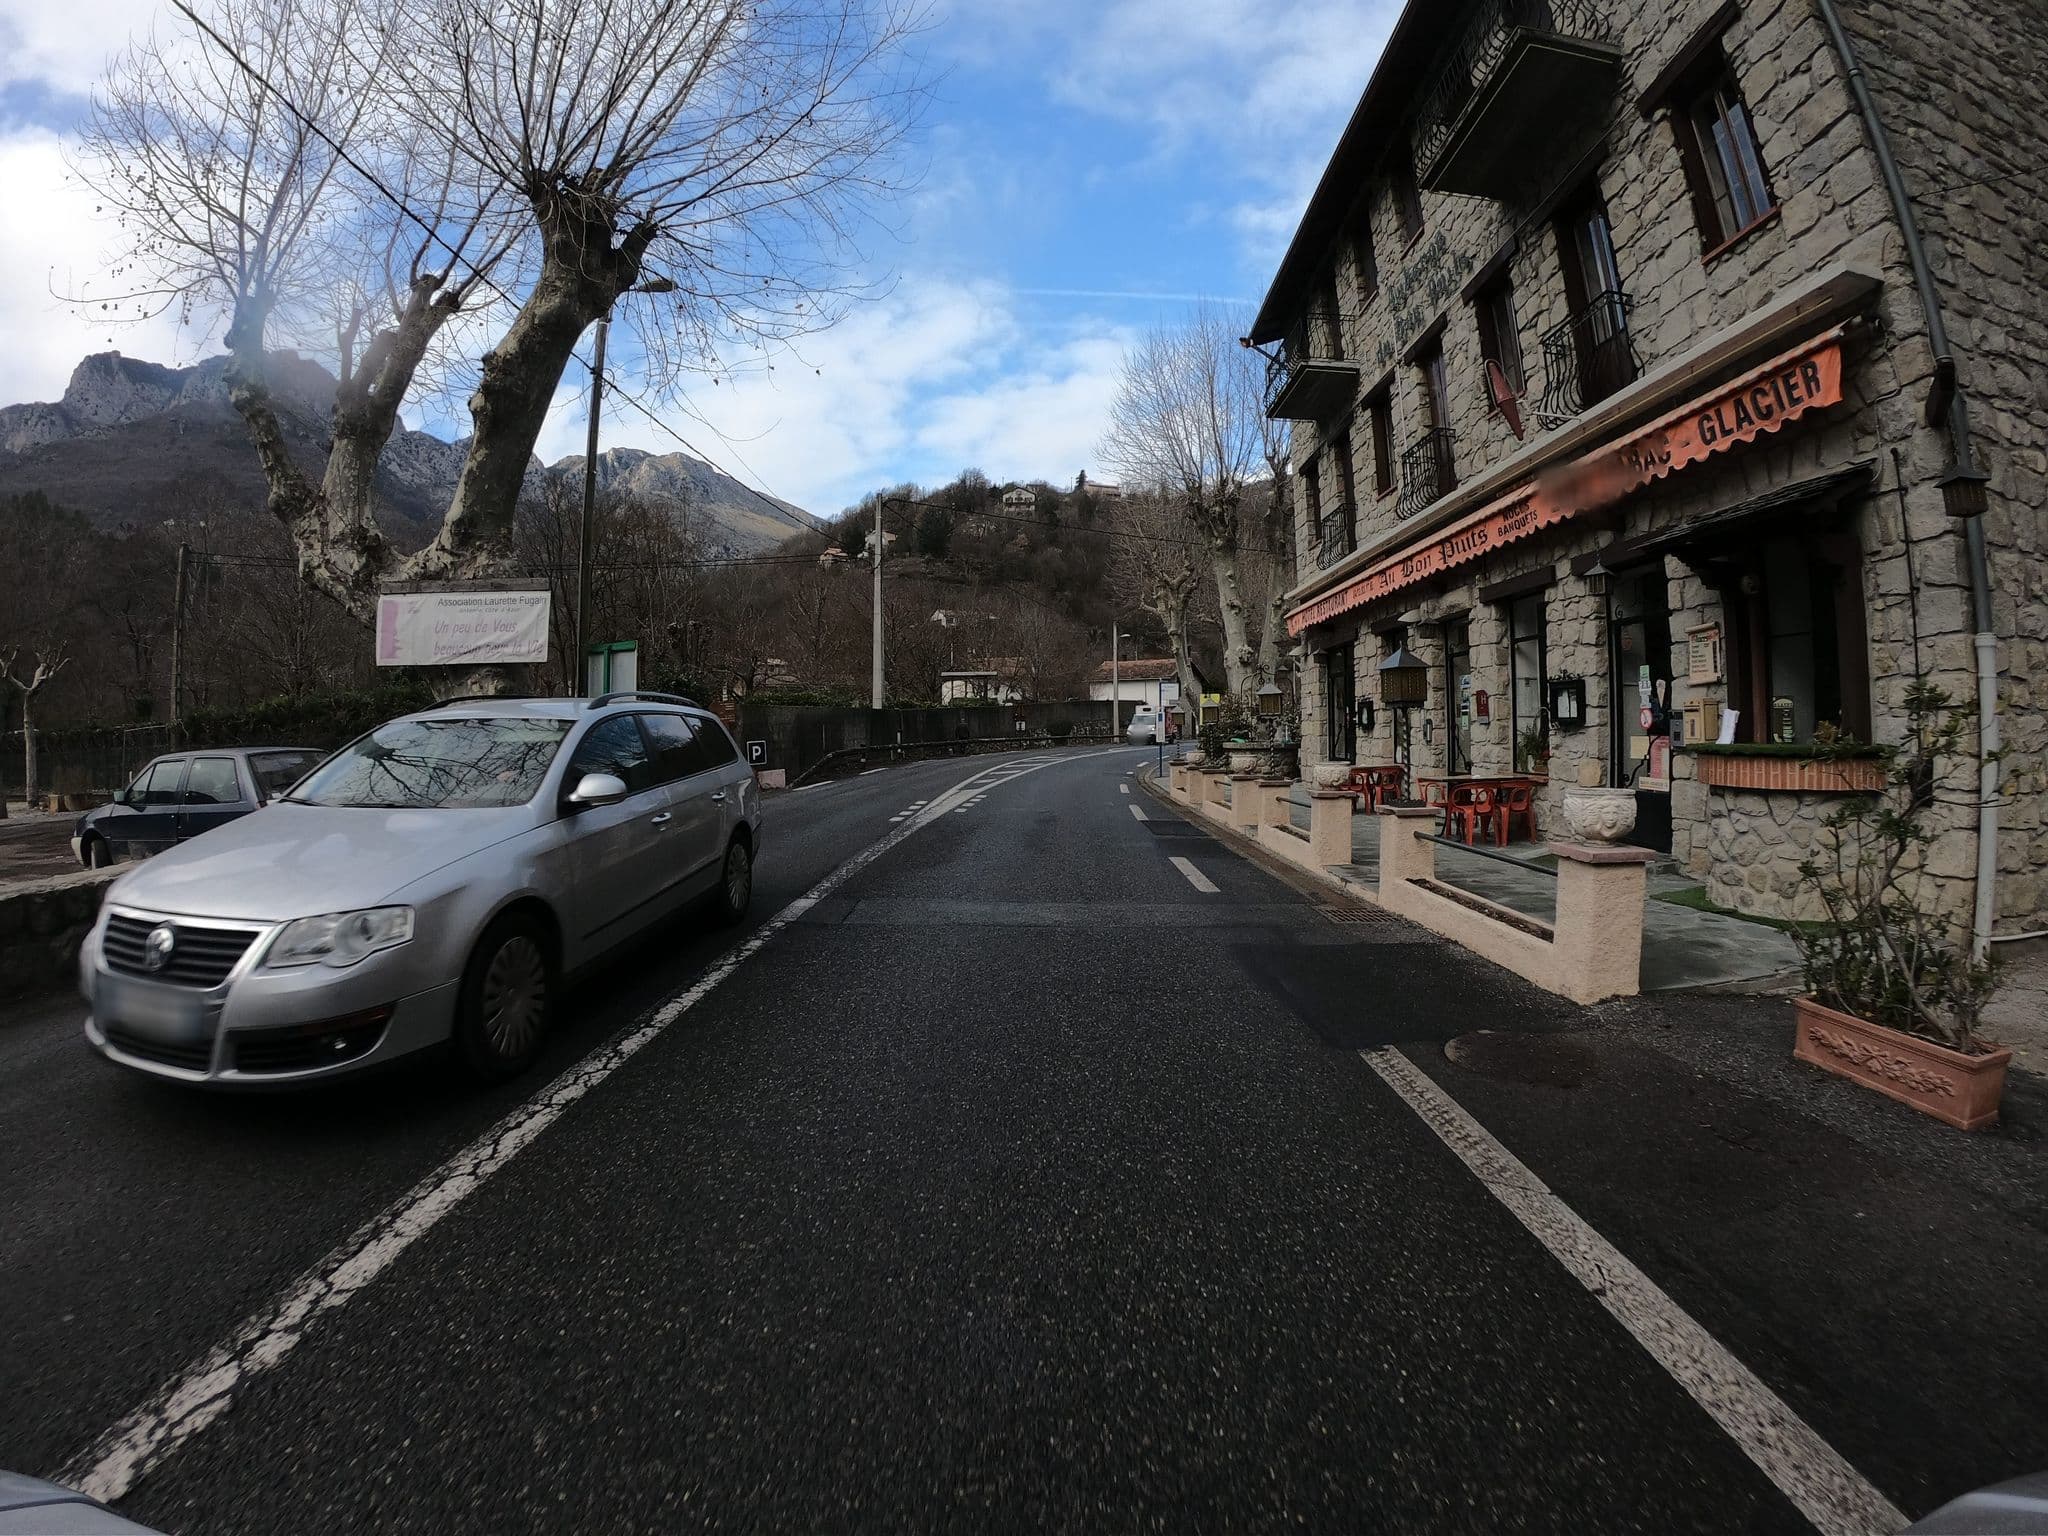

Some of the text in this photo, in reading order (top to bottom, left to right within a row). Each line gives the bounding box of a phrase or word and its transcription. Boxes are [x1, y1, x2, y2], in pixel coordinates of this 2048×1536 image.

[1697, 360, 1821, 446] GLACIER
[1498, 510, 1538, 537] BANQUETS
[1401, 555, 1432, 578] Bon
[1438, 526, 1489, 565] Puits
[437, 596, 547, 607] Association Laurette Fugain
[434, 621, 448, 634] Un
[452, 622, 470, 637] peu
[475, 622, 488, 634] de
[526, 639, 545, 655] Vie
[752, 746, 761, 760] P
